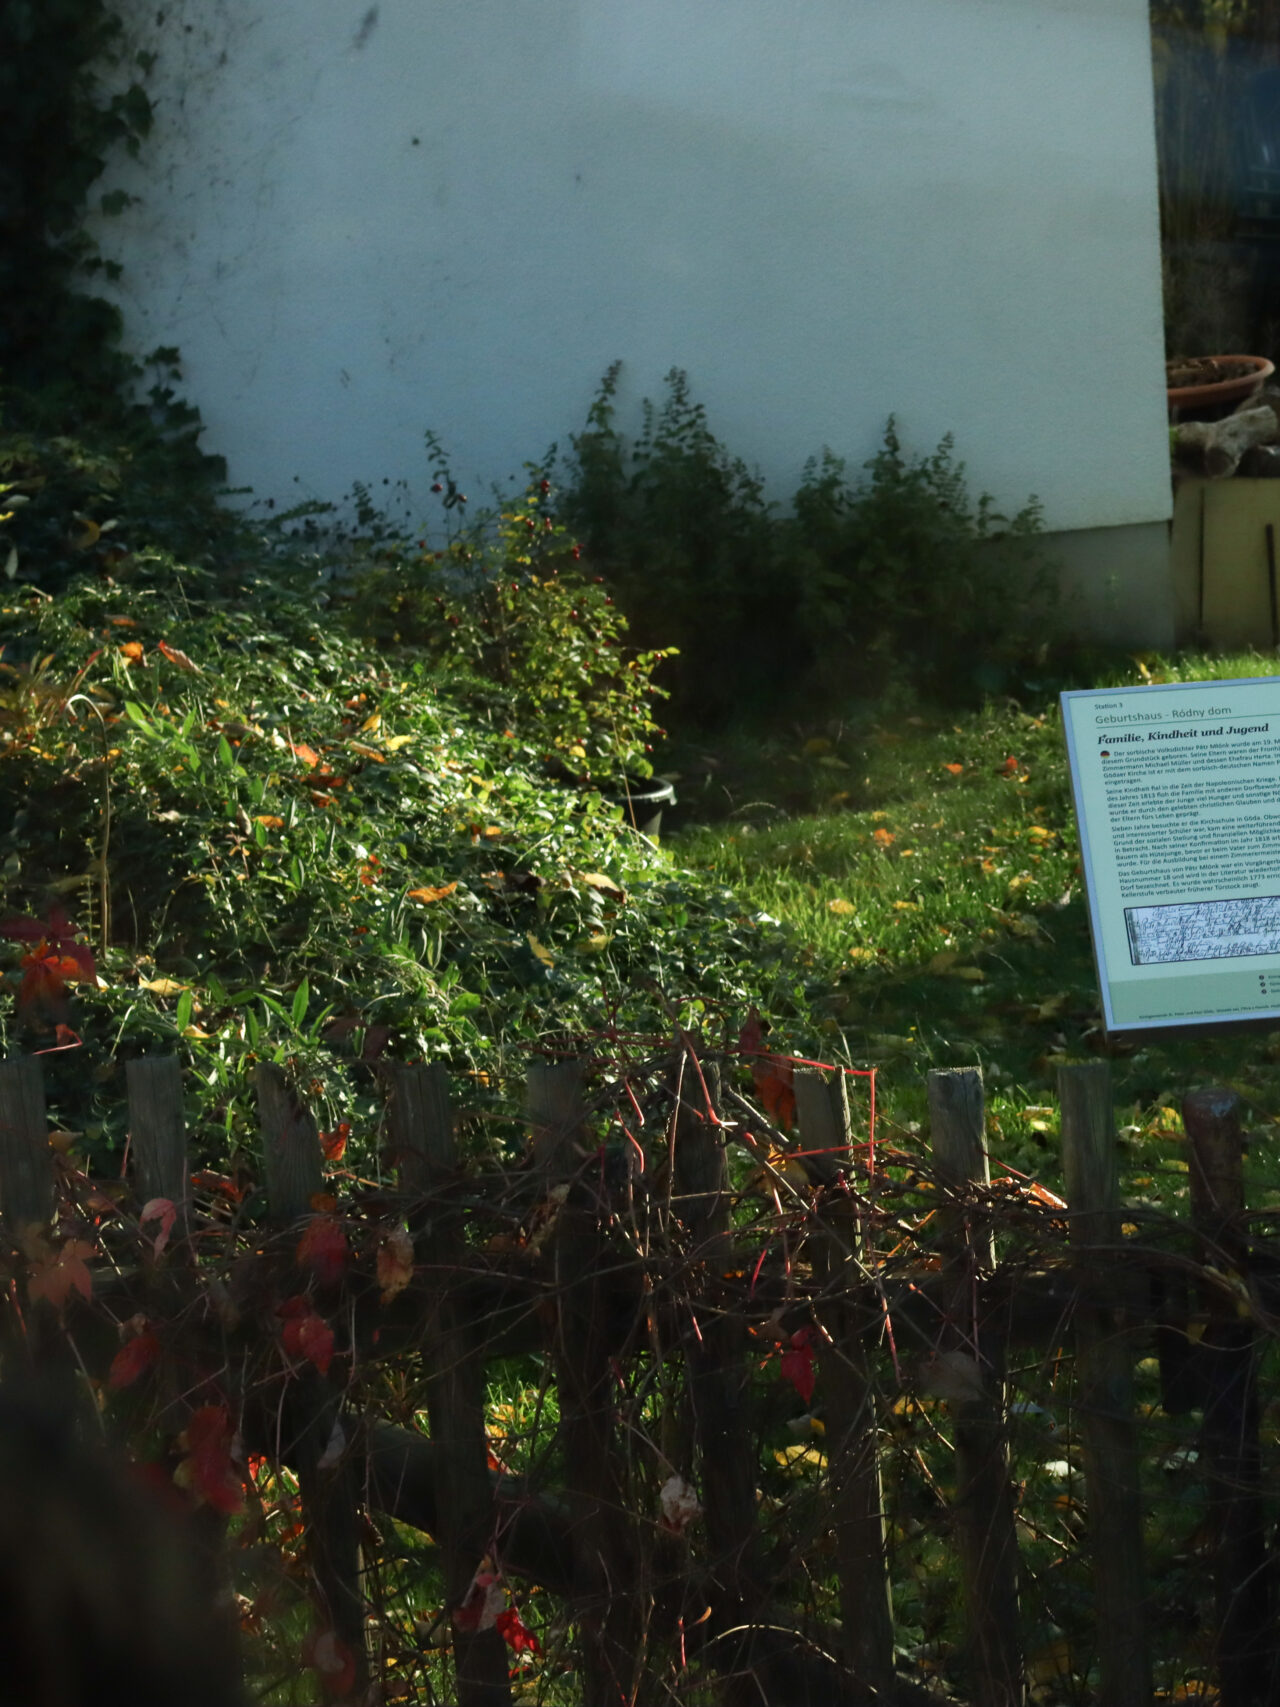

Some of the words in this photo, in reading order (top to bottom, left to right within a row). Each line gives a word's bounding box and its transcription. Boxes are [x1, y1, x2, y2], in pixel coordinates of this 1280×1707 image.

[1095, 712, 1162, 724] Geburtshaus
[1172, 709, 1205, 719] Ródny
[1207, 707, 1232, 716] dom
[1097, 733, 1144, 745] Familie,
[1147, 728, 1198, 741] Kindheit
[1200, 726, 1224, 737] und
[1225, 722, 1269, 736] Jugend
